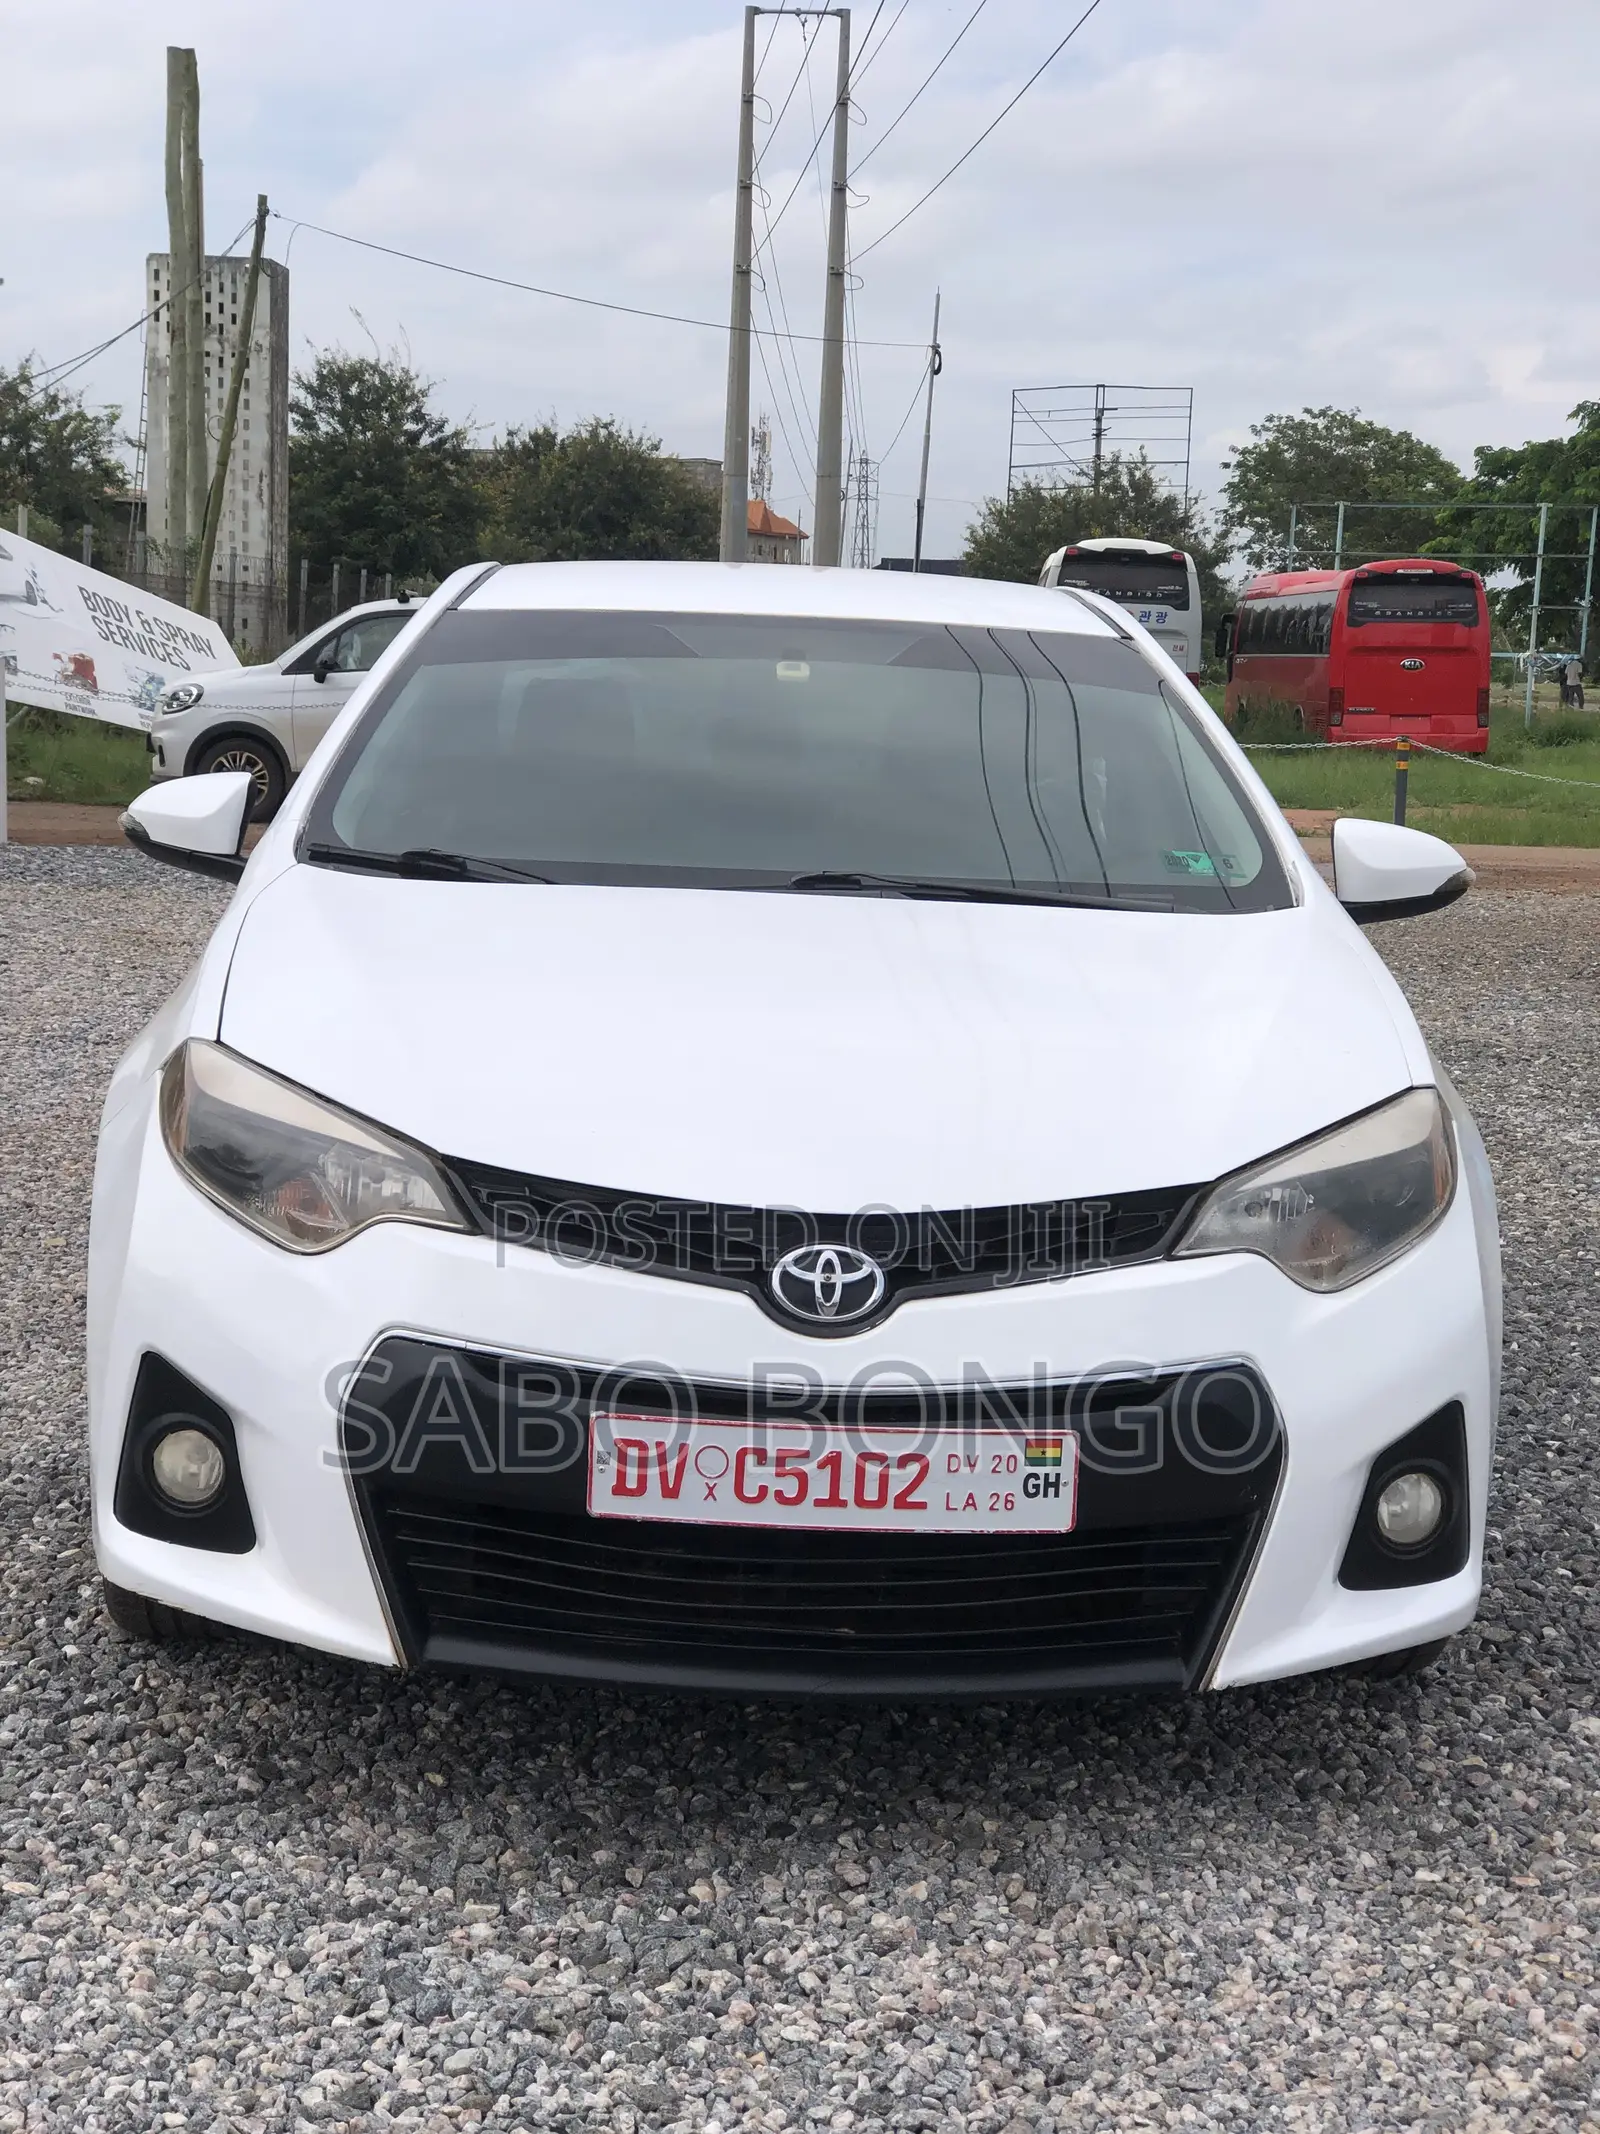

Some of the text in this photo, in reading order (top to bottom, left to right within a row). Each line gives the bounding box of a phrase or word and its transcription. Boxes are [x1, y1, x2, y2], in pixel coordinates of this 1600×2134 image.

[77, 585, 217, 660] BODY & SPRAY
[91, 615, 191, 671] SERVICES
[1403, 660, 1422, 669] KIA
[610, 1438, 931, 1511] DV C5102
[946, 1454, 1018, 1475] DV 20
[1022, 1472, 1062, 1499] GH
[945, 1492, 1016, 1512] LA 26
